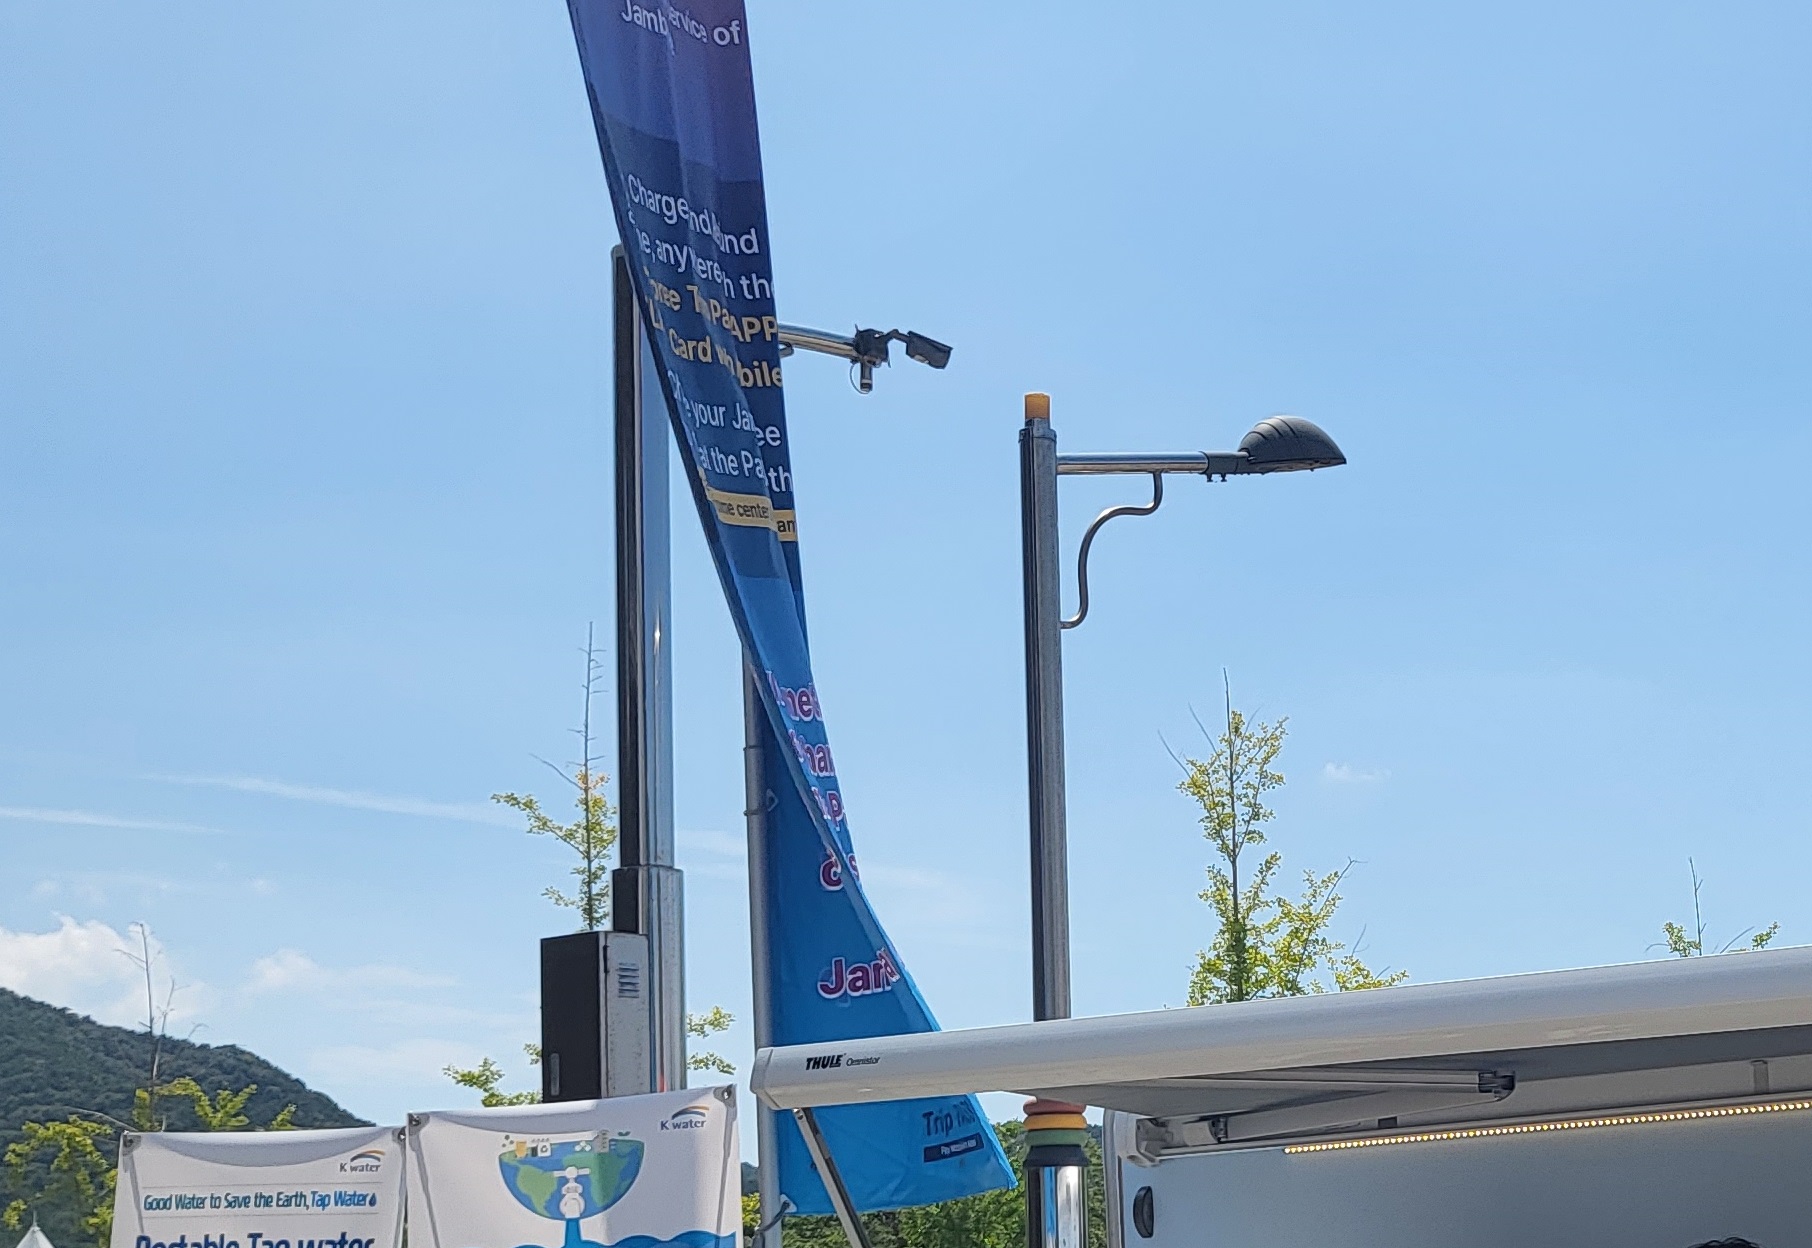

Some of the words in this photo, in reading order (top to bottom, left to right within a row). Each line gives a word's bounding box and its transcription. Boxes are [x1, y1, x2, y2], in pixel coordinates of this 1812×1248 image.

[713, 21, 742, 46] of
[628, 174, 690, 224] Charge
[806, 1055, 843, 1070] THULE
[661, 1120, 669, 1131] K
[673, 1117, 707, 1131] water
[339, 1163, 347, 1172] K
[350, 1162, 381, 1173] water
[144, 1194, 171, 1211] Good
[175, 1194, 207, 1210] Water
[210, 1193, 221, 1209] to
[224, 1193, 250, 1209] Save
[254, 1192, 272, 1208] the
[276, 1191, 310, 1210] Earth,
[311, 1191, 330, 1211] Tap
[334, 1191, 369, 1206] Water
